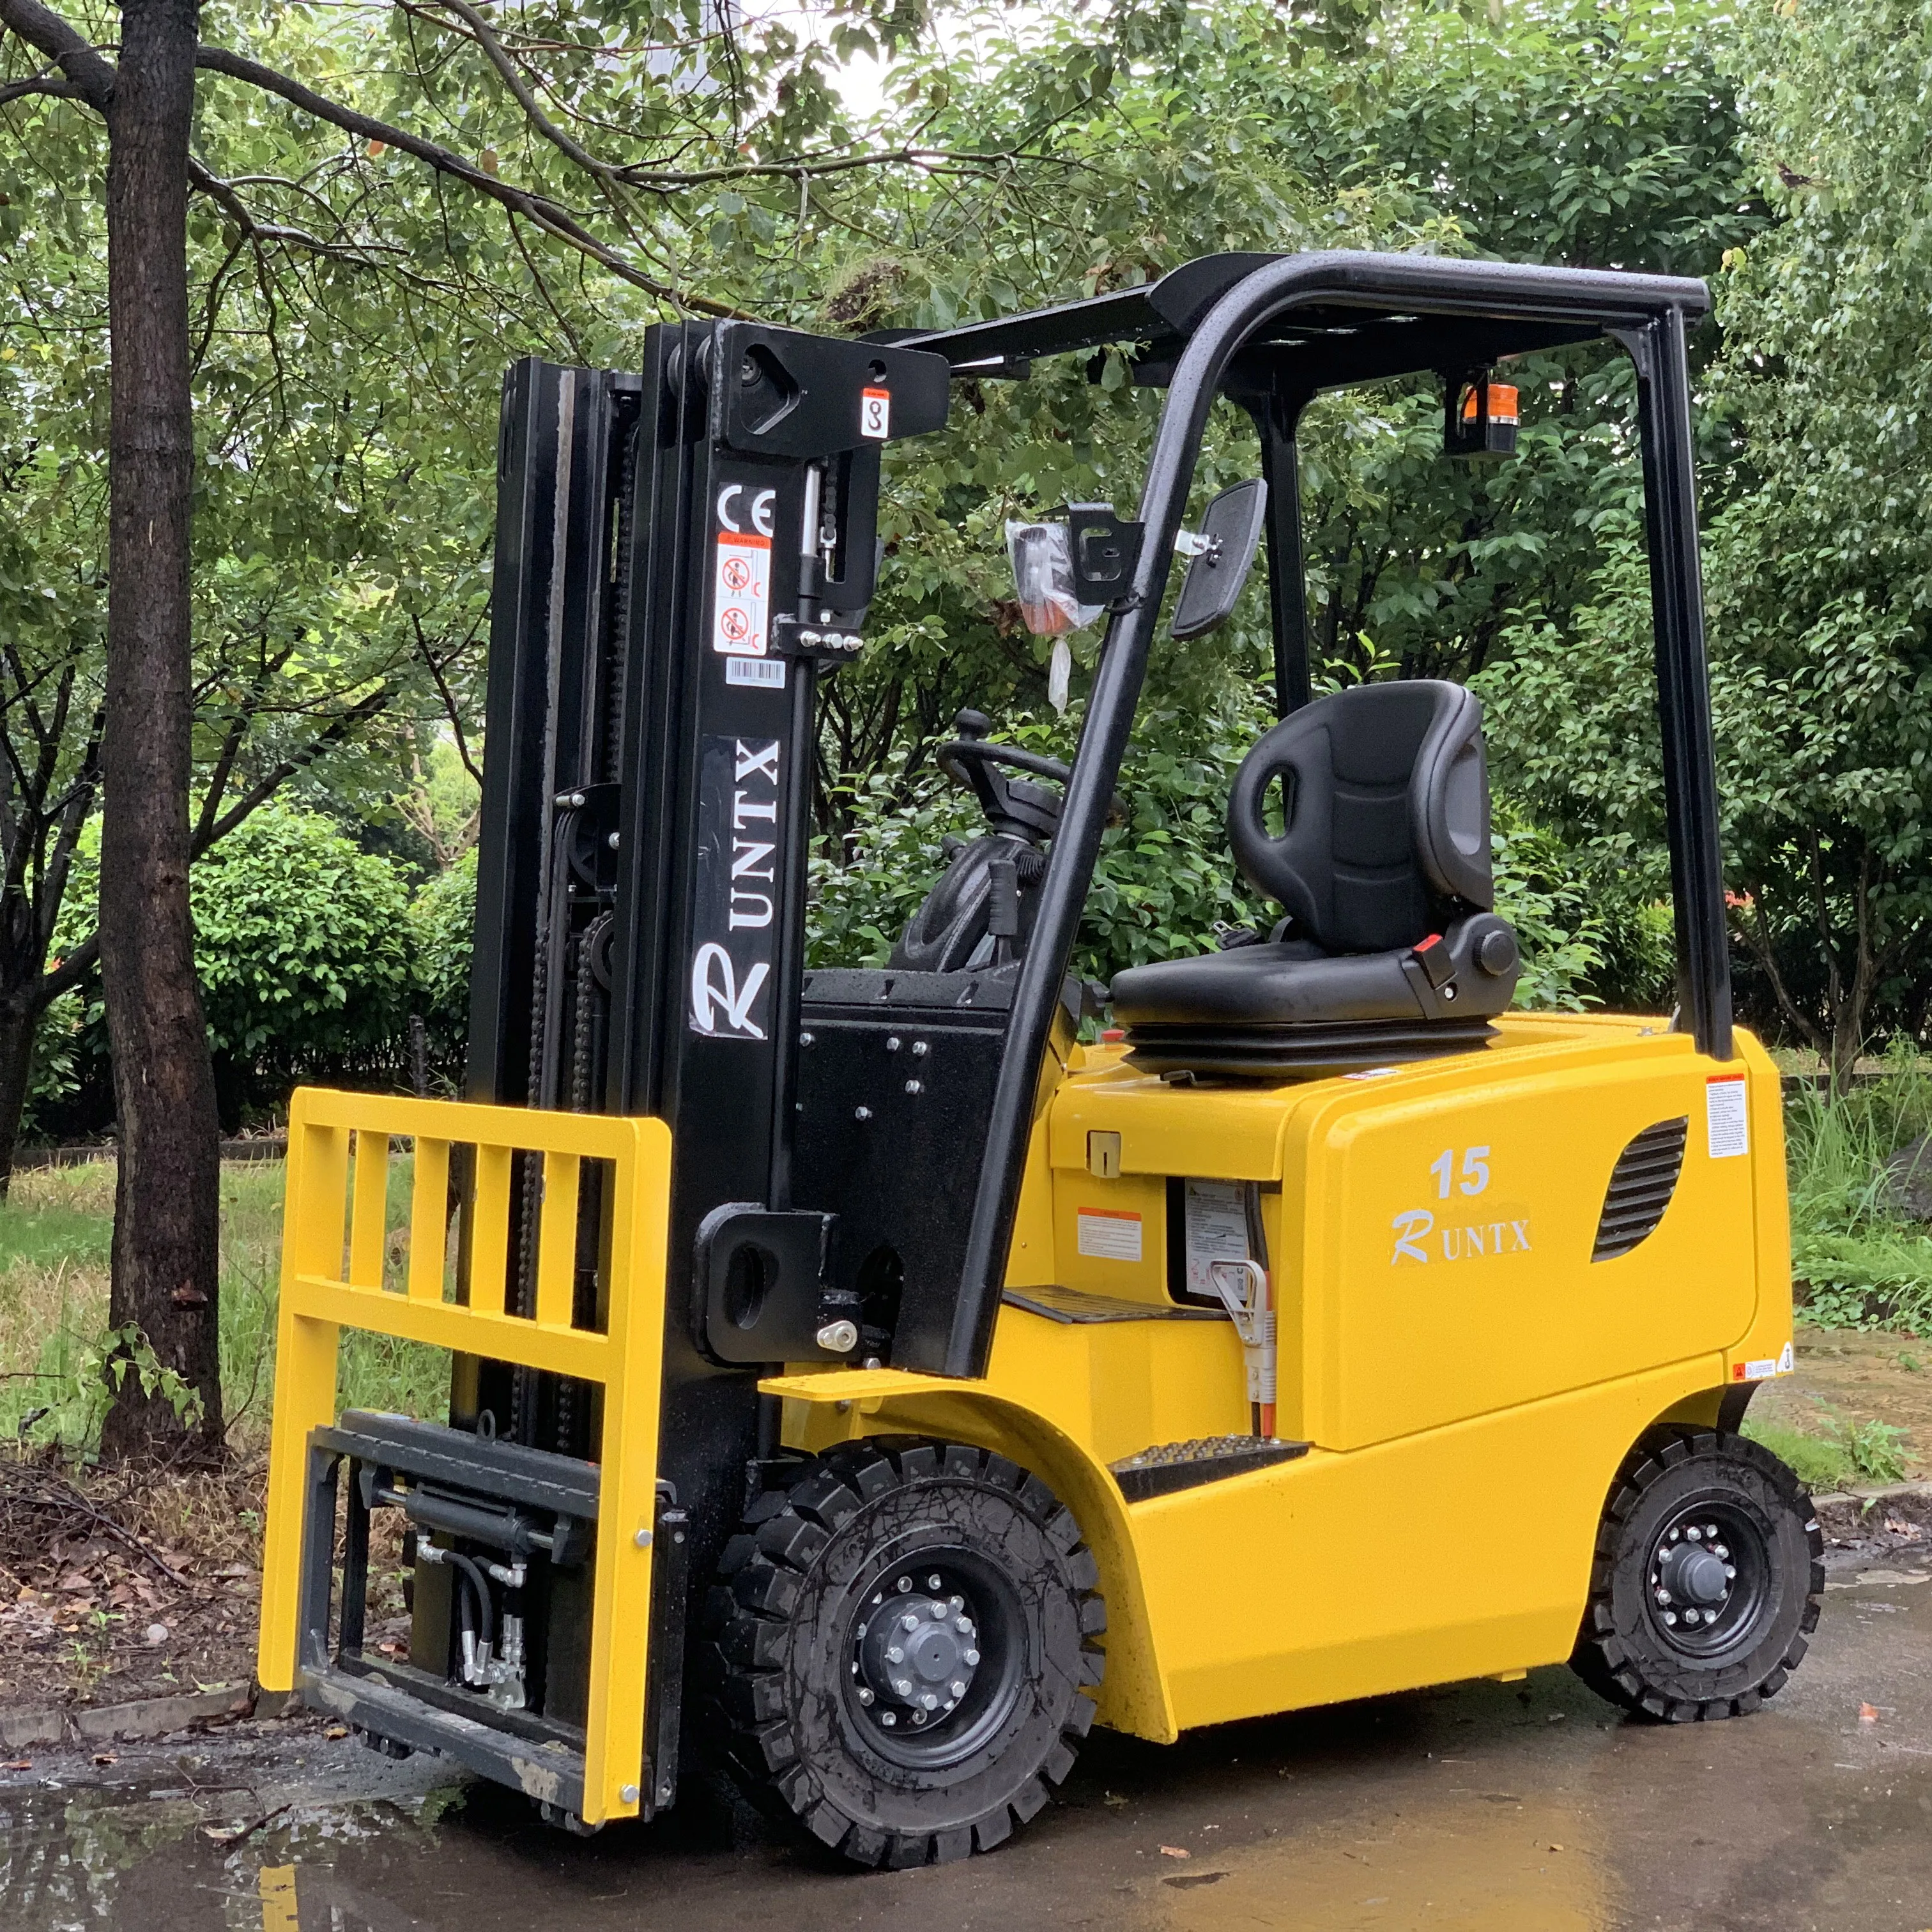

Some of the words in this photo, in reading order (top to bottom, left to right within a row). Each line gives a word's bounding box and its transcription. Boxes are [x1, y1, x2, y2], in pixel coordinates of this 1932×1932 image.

[717, 485, 776, 537] CE
[733, 537, 765, 547] WARNING
[1430, 1146, 1491, 1199] 15
